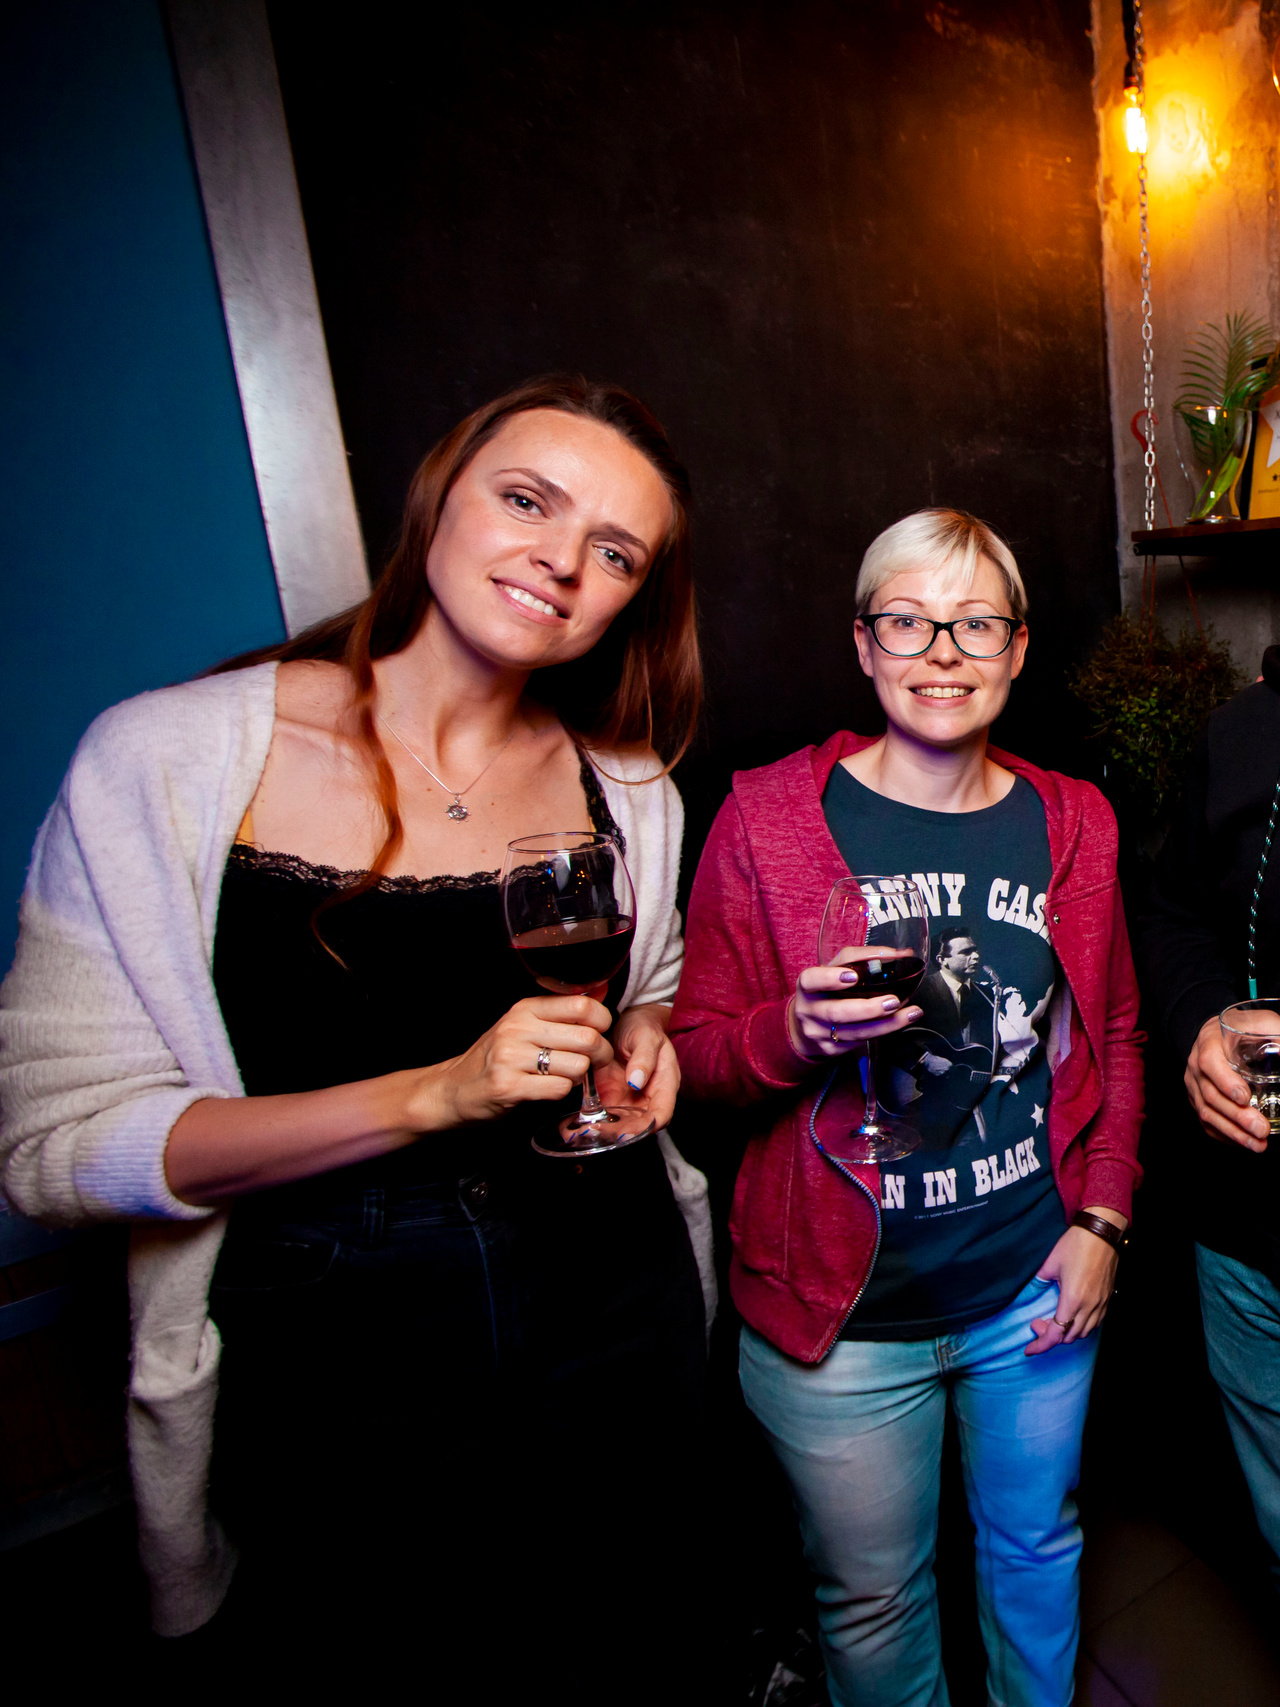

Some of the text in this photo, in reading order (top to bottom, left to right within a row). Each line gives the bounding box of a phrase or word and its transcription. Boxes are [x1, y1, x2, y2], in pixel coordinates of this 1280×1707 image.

[987, 877, 1051, 946] CAS
[881, 1136, 1041, 1210] N IN BLACK
